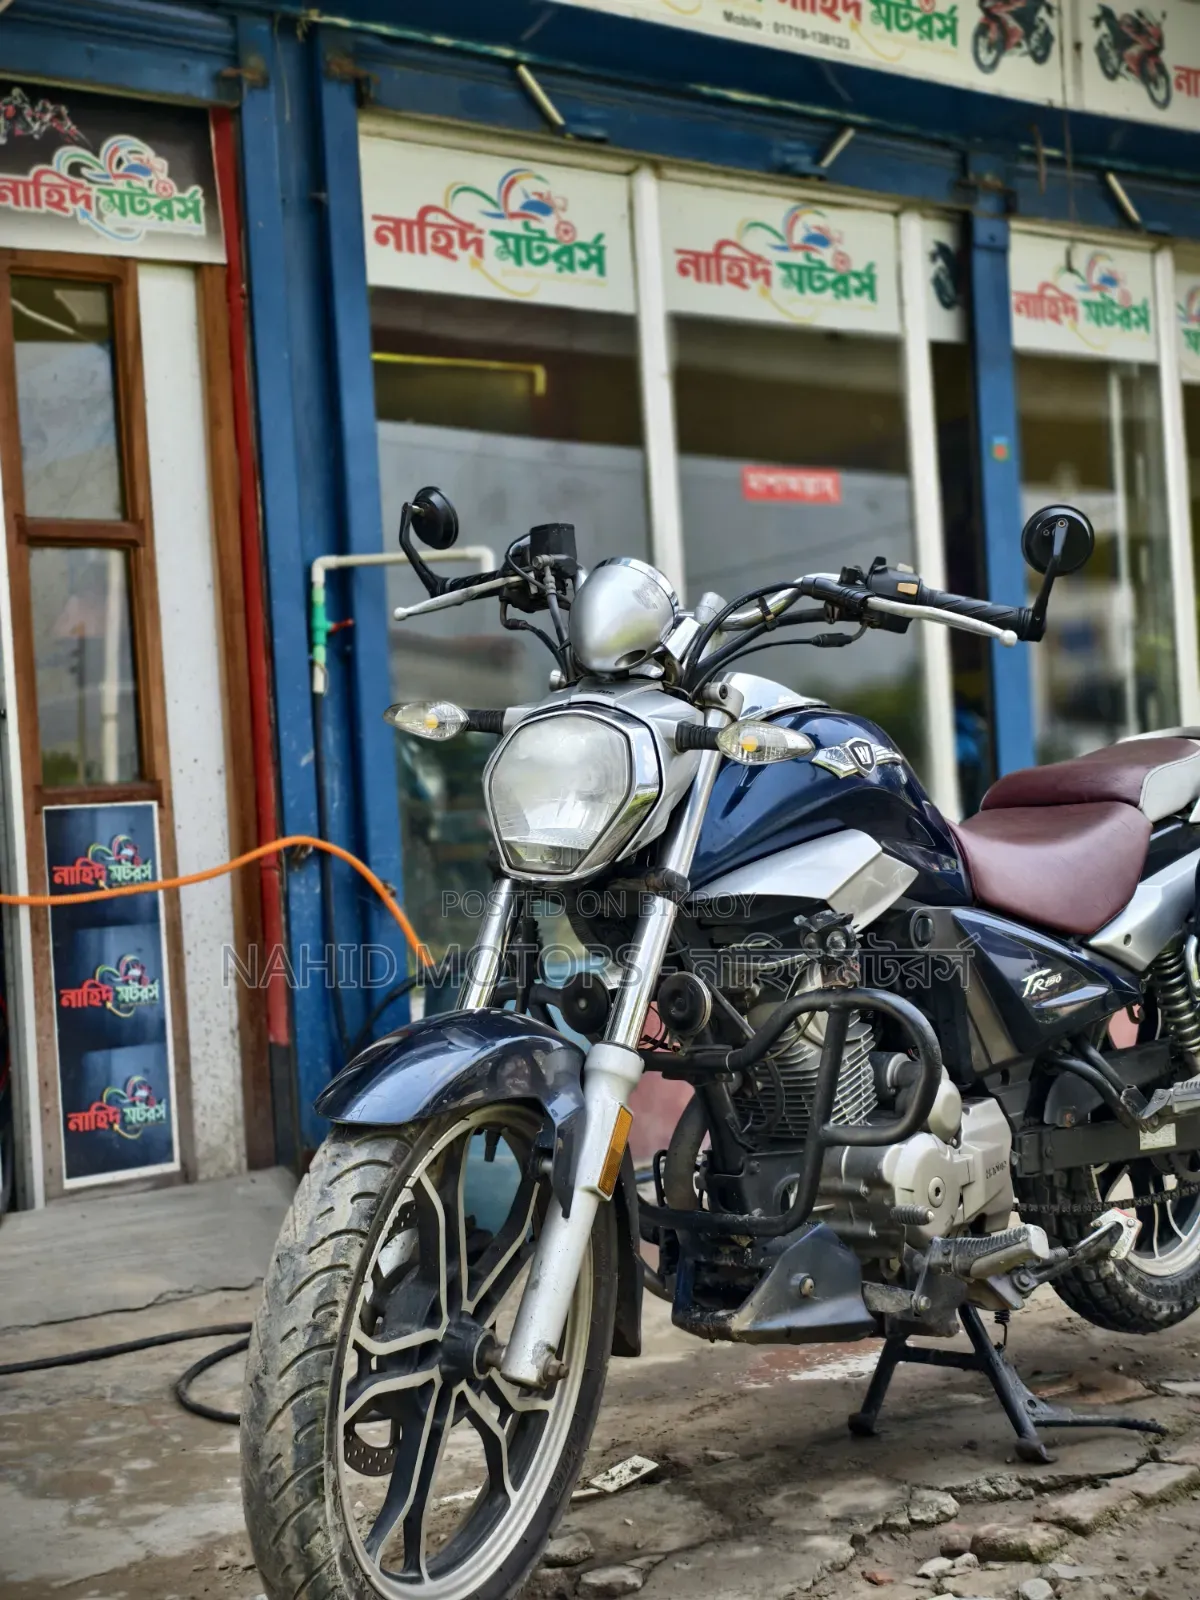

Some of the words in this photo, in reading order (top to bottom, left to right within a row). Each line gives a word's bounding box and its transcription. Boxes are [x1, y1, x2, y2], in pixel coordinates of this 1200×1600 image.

[723, 9, 763, 31] Mobile
[372, 204, 485, 262] নাহিদ
[675, 239, 772, 290] নাহিদ
[52, 856, 106, 886] নাহিদ
[60, 978, 113, 1008] নাহিদ
[67, 1100, 120, 1132] নাহিদ
